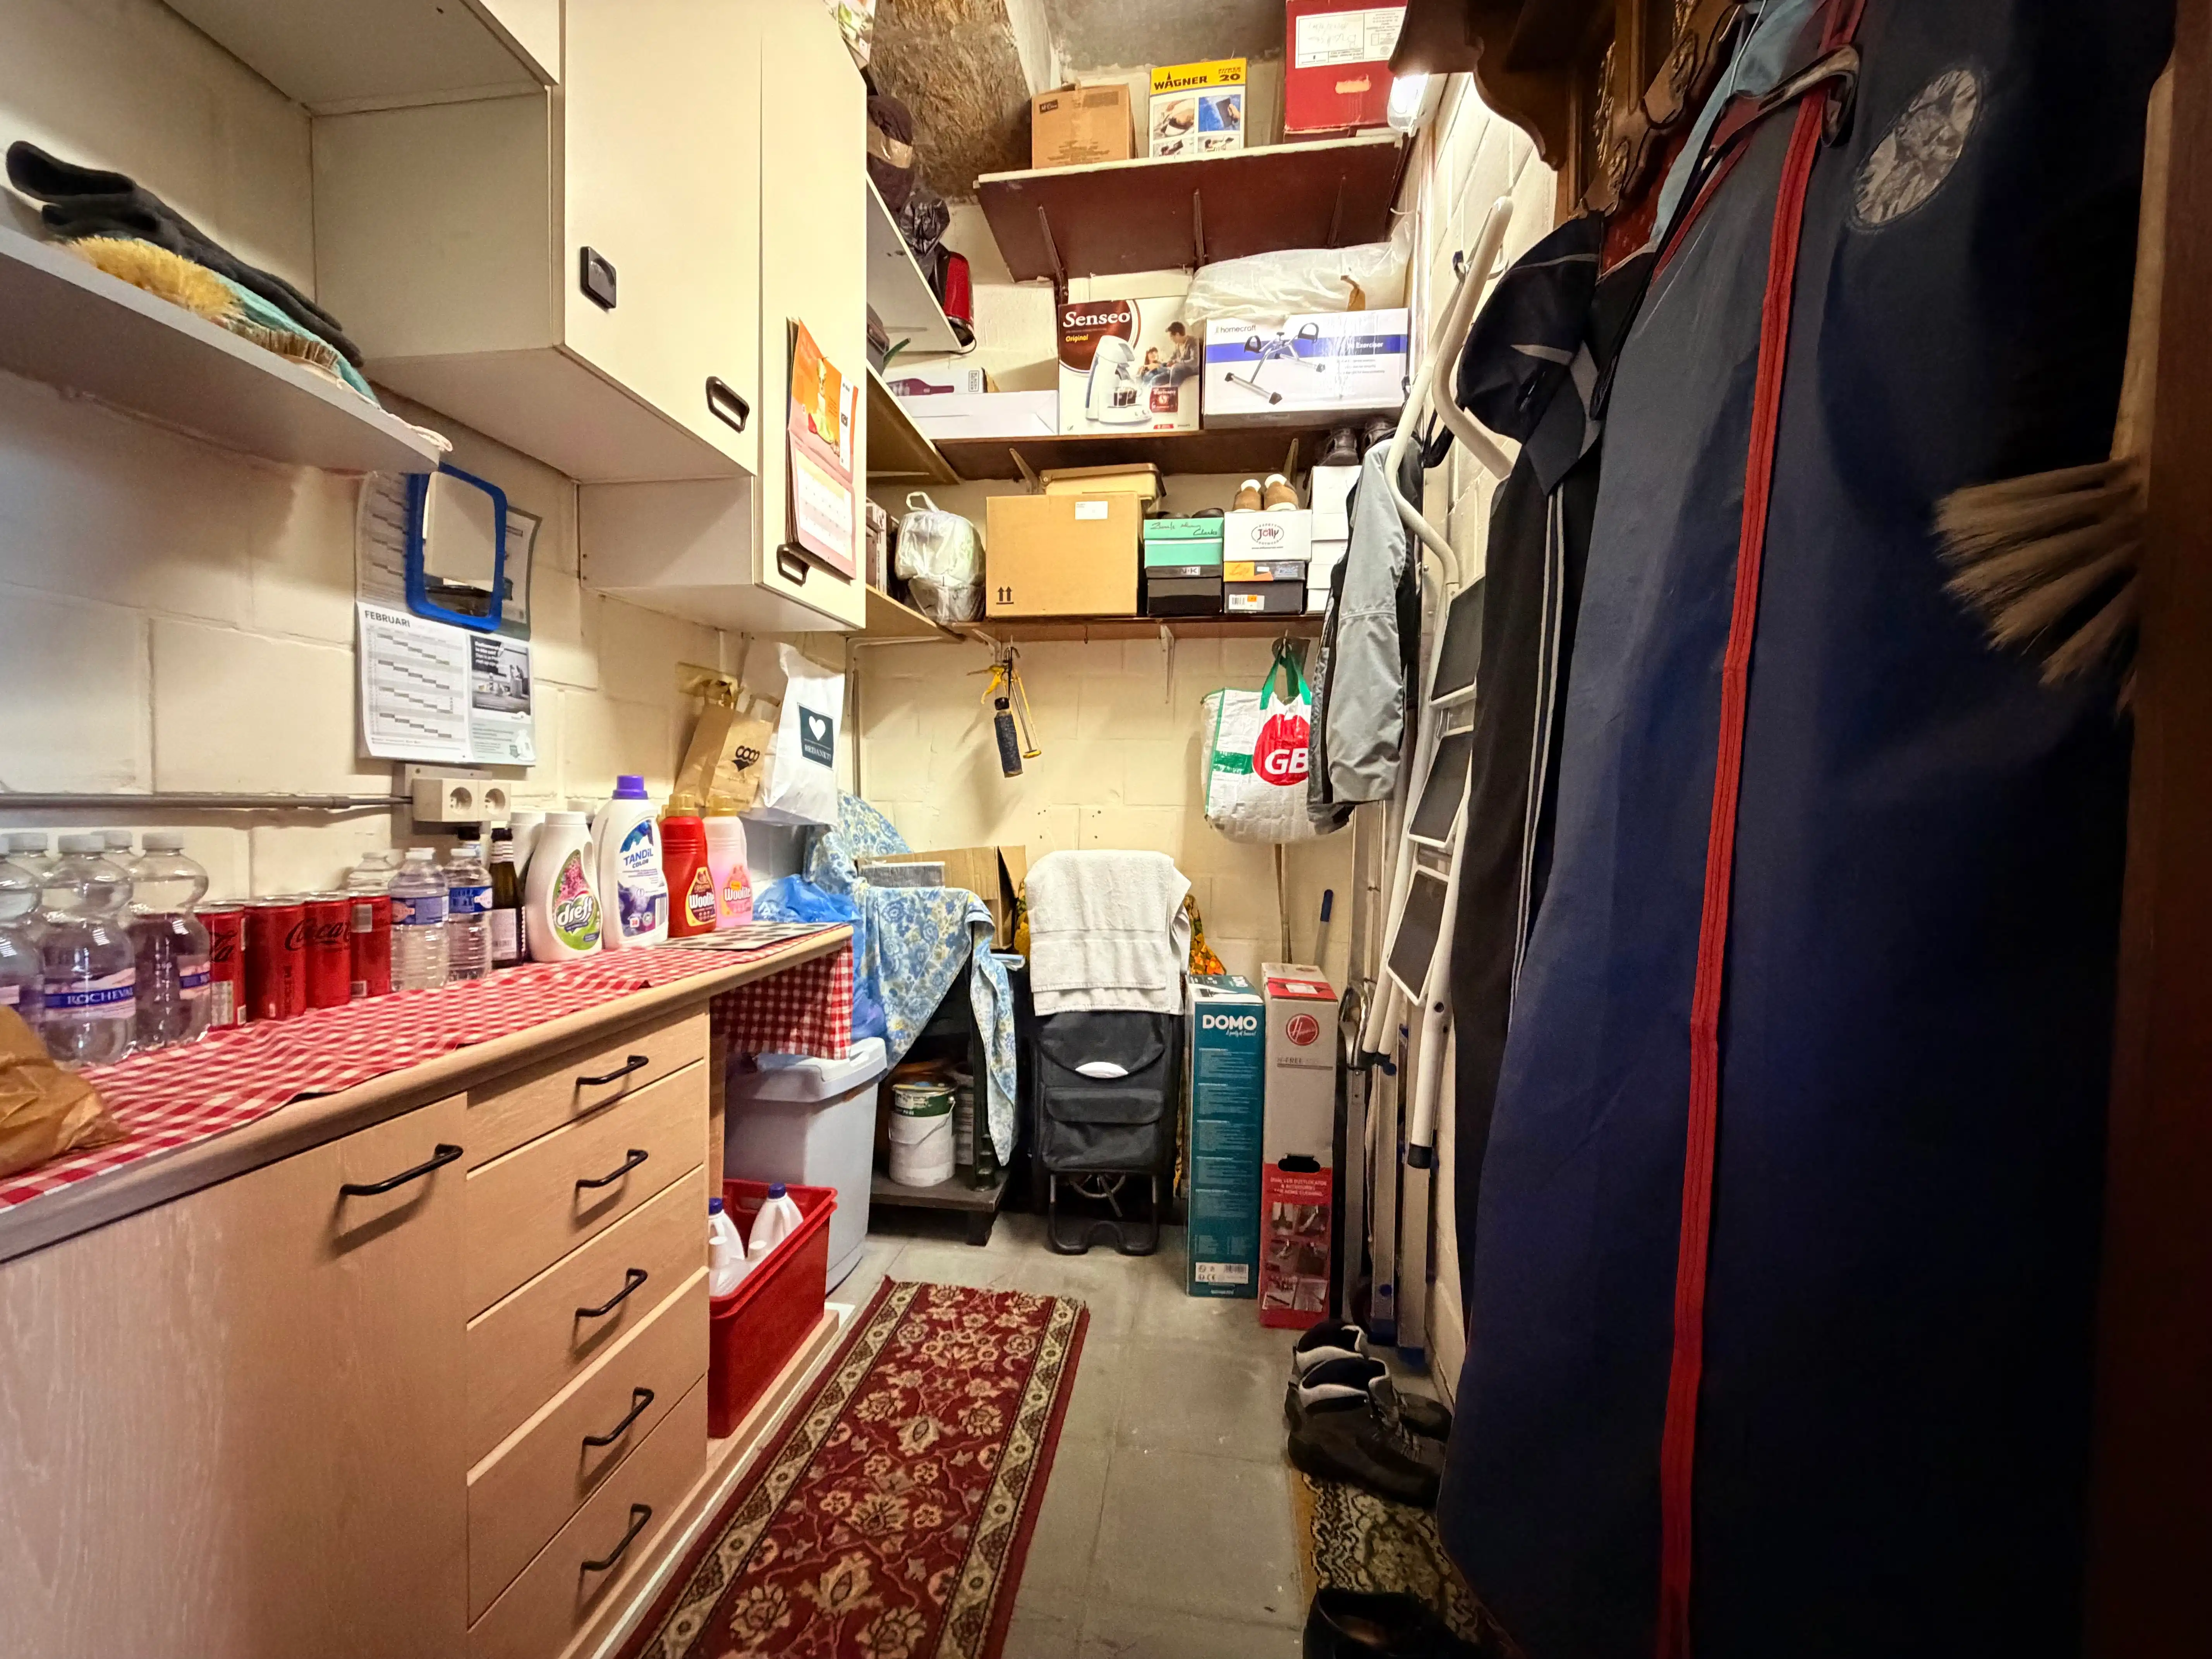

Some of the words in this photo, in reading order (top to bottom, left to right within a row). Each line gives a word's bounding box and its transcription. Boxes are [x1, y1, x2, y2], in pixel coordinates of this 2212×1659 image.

[1154, 71, 1207, 90] WAGNER
[1219, 73, 1241, 82] 20
[1063, 311, 1130, 328] Senseo
[1066, 334, 1089, 343] Original
[1257, 528, 1279, 541] Jolly
[364, 610, 410, 628] FEBRUARI
[1264, 748, 1309, 775] GB
[632, 859, 649, 868] COLOR
[689, 891, 715, 909] Woolite
[725, 885, 751, 901] Woolite
[557, 896, 593, 926] dreft
[1202, 1015, 1257, 1030] DOMO
